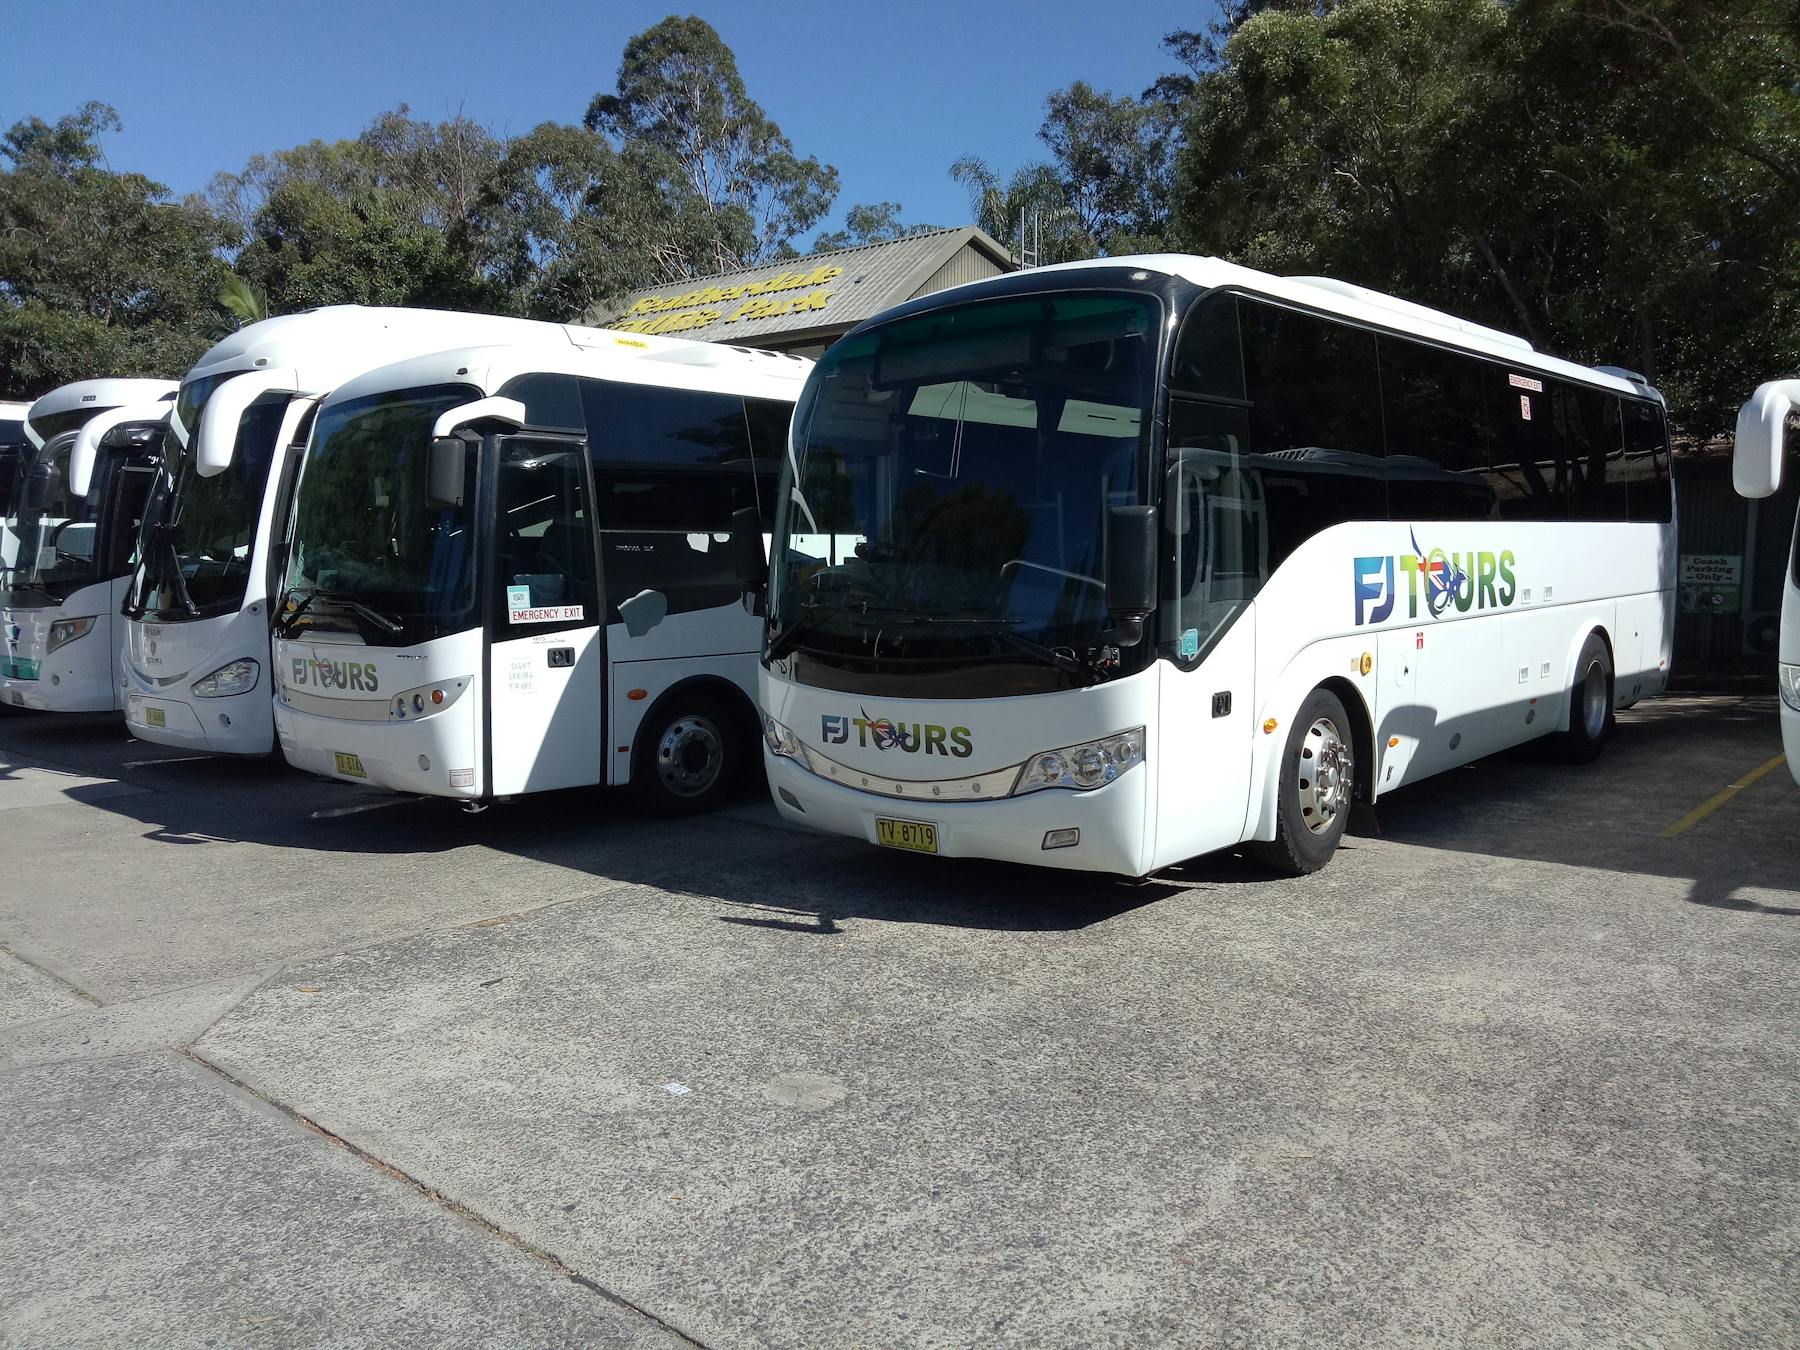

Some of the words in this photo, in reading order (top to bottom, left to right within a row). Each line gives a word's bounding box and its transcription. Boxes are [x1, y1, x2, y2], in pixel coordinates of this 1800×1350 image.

[624, 265, 844, 317] Featherdale
[724, 288, 835, 324] Park
[1686, 565, 1735, 576] Parking
[1695, 573, 1724, 581] Only
[512, 608, 559, 621] EMERGENCY
[564, 607, 581, 618] EXIT
